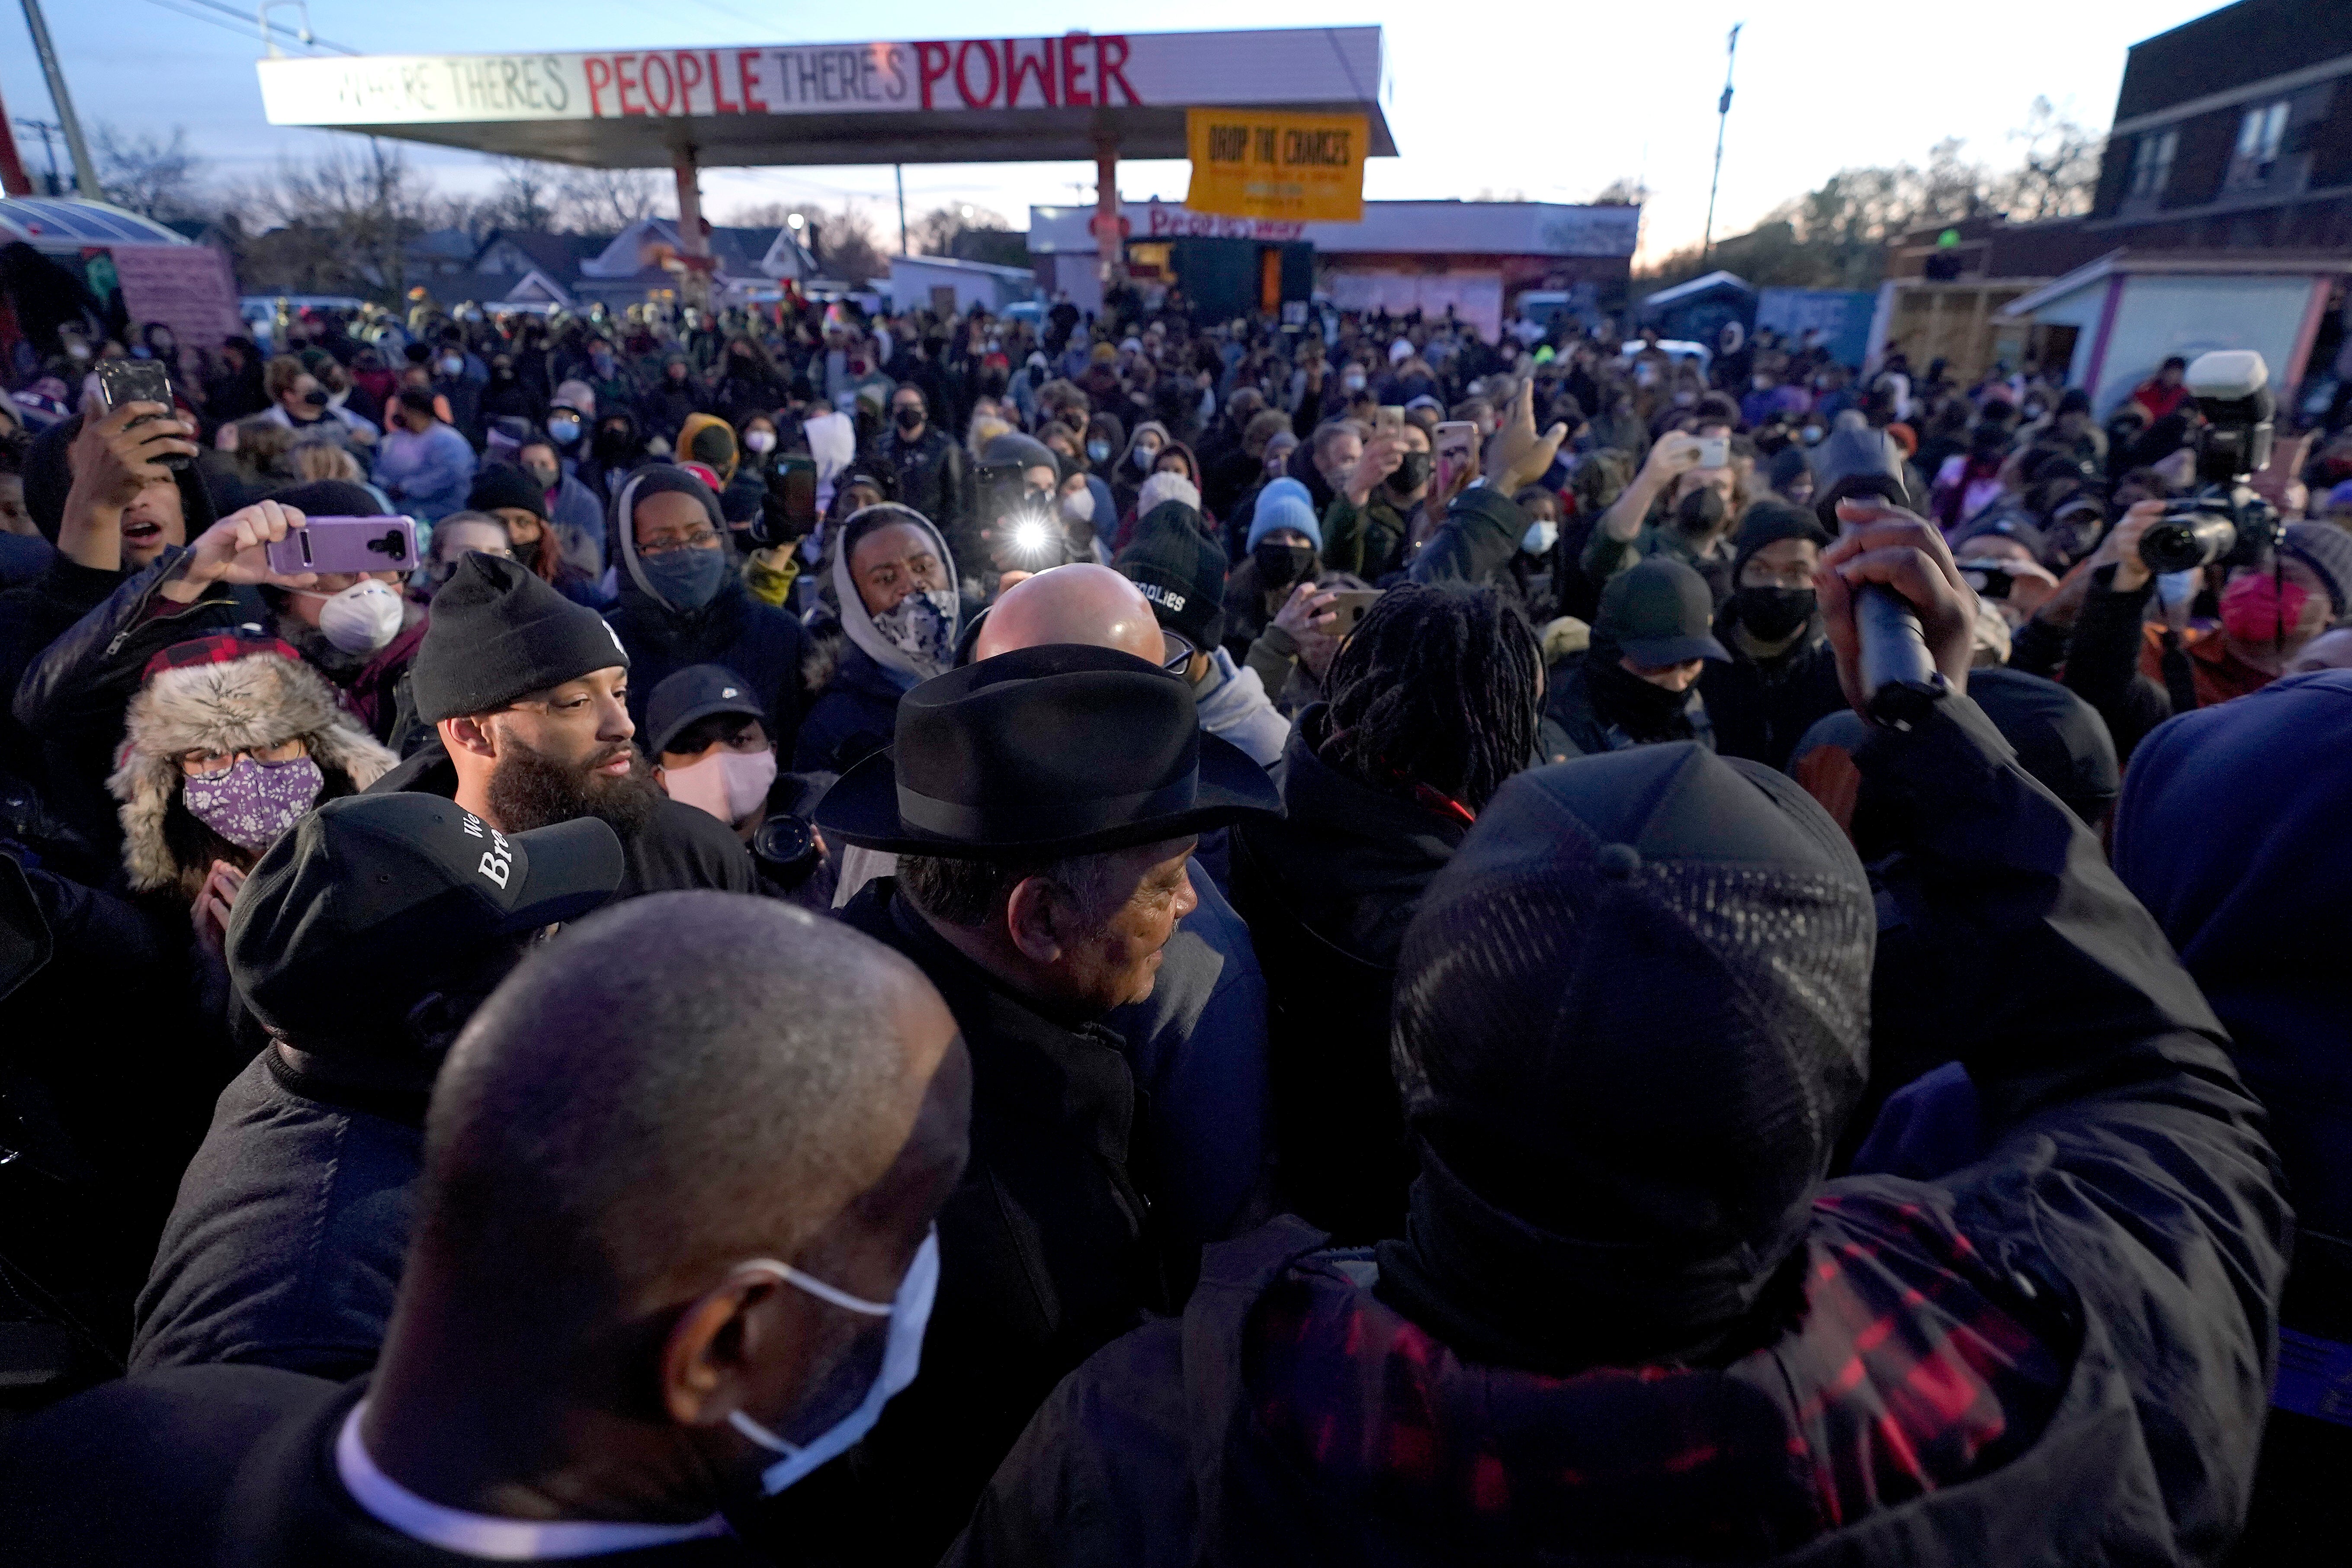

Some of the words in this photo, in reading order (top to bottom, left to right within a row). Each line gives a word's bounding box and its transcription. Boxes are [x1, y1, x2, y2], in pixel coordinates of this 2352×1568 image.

[584, 49, 768, 115] PEOPLE
[912, 34, 1142, 109] POWER
[463, 813, 483, 838] We
